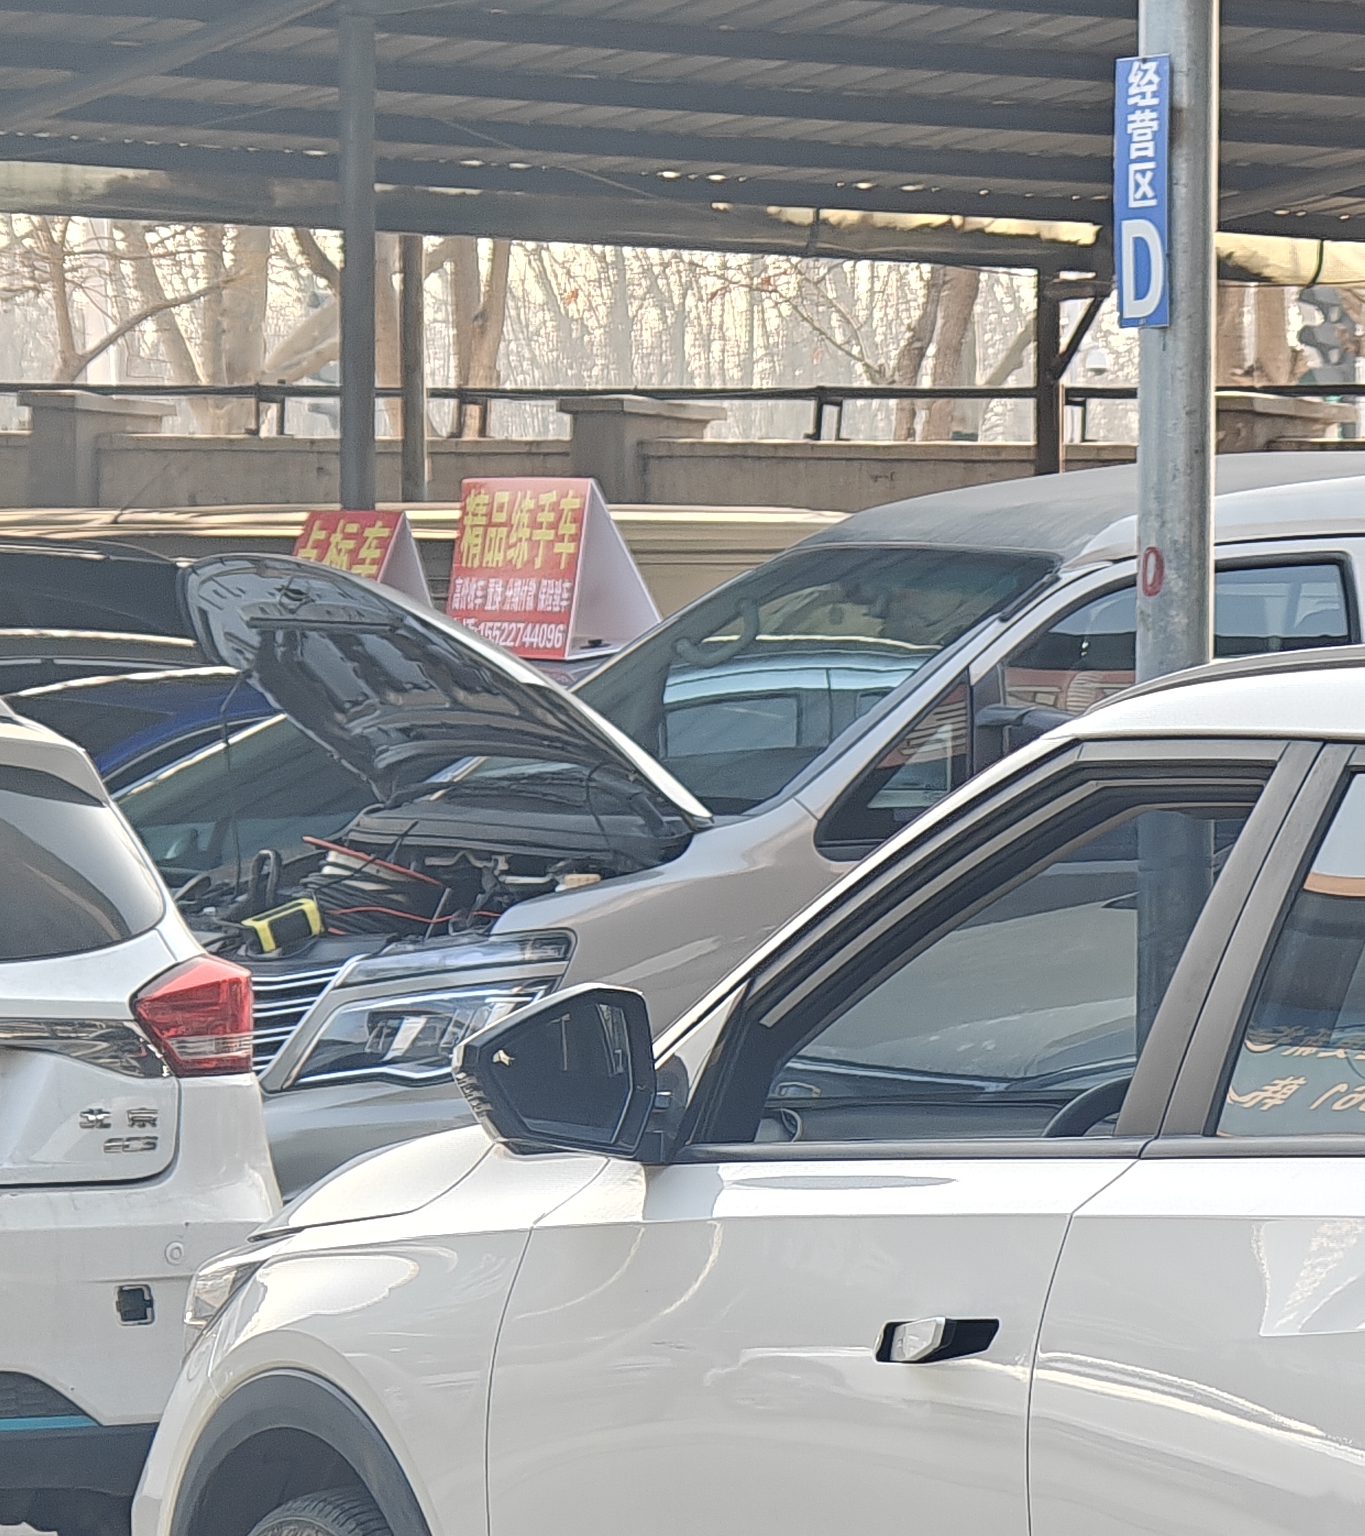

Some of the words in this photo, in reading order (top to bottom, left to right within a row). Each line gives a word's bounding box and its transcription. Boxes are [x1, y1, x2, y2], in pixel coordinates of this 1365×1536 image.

[1126, 61, 1161, 208] 经营区
[1121, 218, 1165, 320] D
[460, 487, 582, 570] 精品练手车
